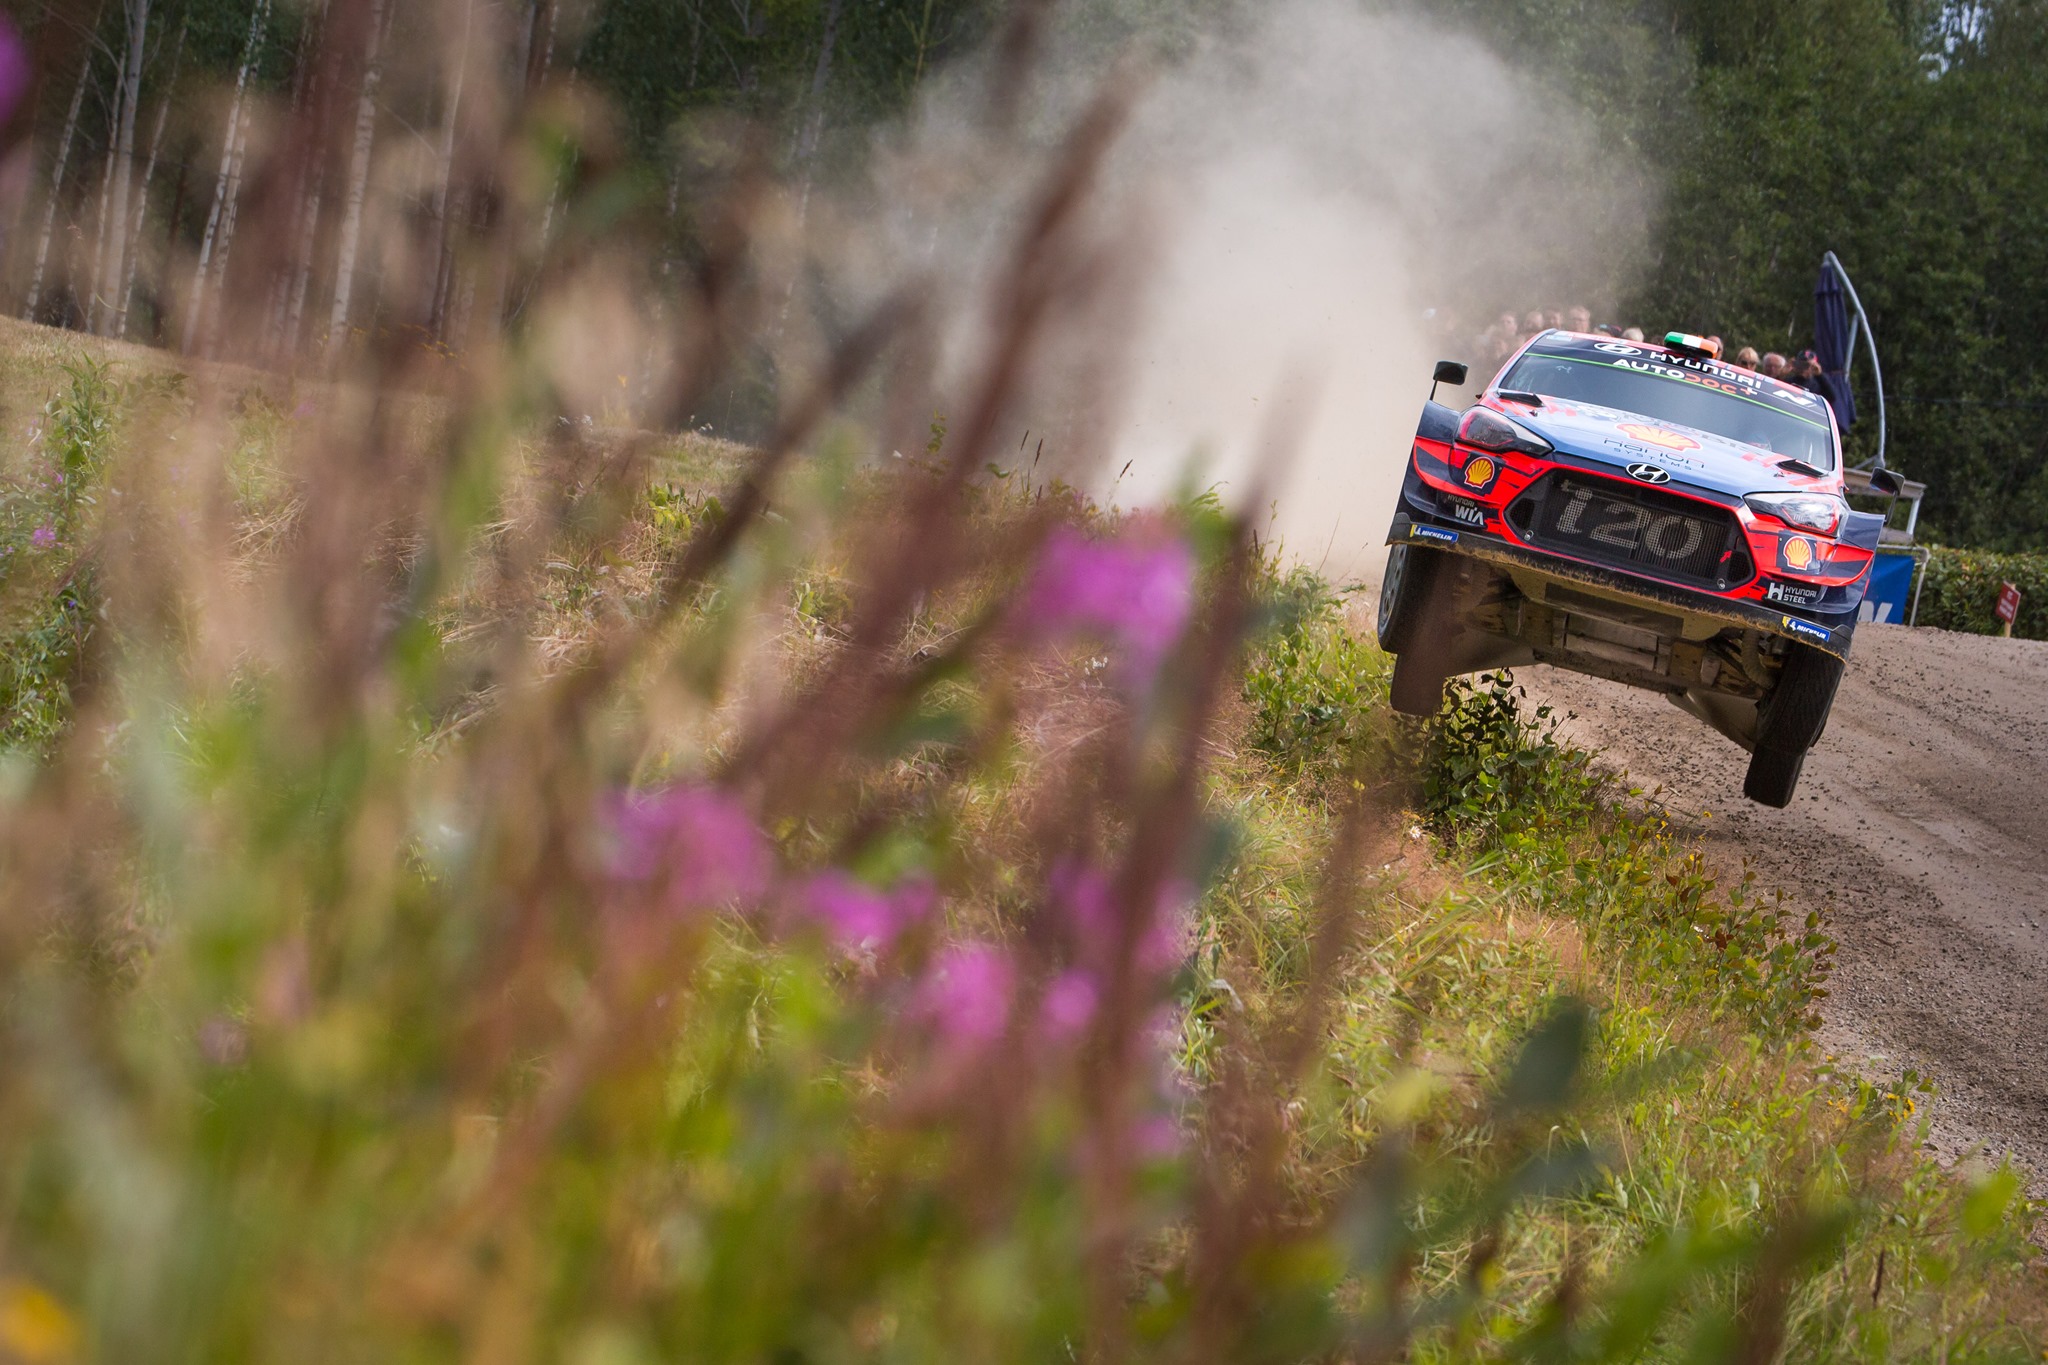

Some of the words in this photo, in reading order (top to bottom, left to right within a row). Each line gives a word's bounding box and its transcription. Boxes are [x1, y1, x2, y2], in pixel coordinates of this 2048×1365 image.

[1649, 350, 1762, 389] HYUNDAI
[1613, 447, 1693, 471] SYSTEMS
[1447, 493, 1475, 507] HYUNDAI
[1556, 487, 1703, 560] i20
[1421, 529, 1453, 541] MICHELIN
[1783, 593, 1806, 605] STEEL
[1785, 585, 1818, 598] HYUNDAI
[1796, 623, 1827, 640] MICHELIN
